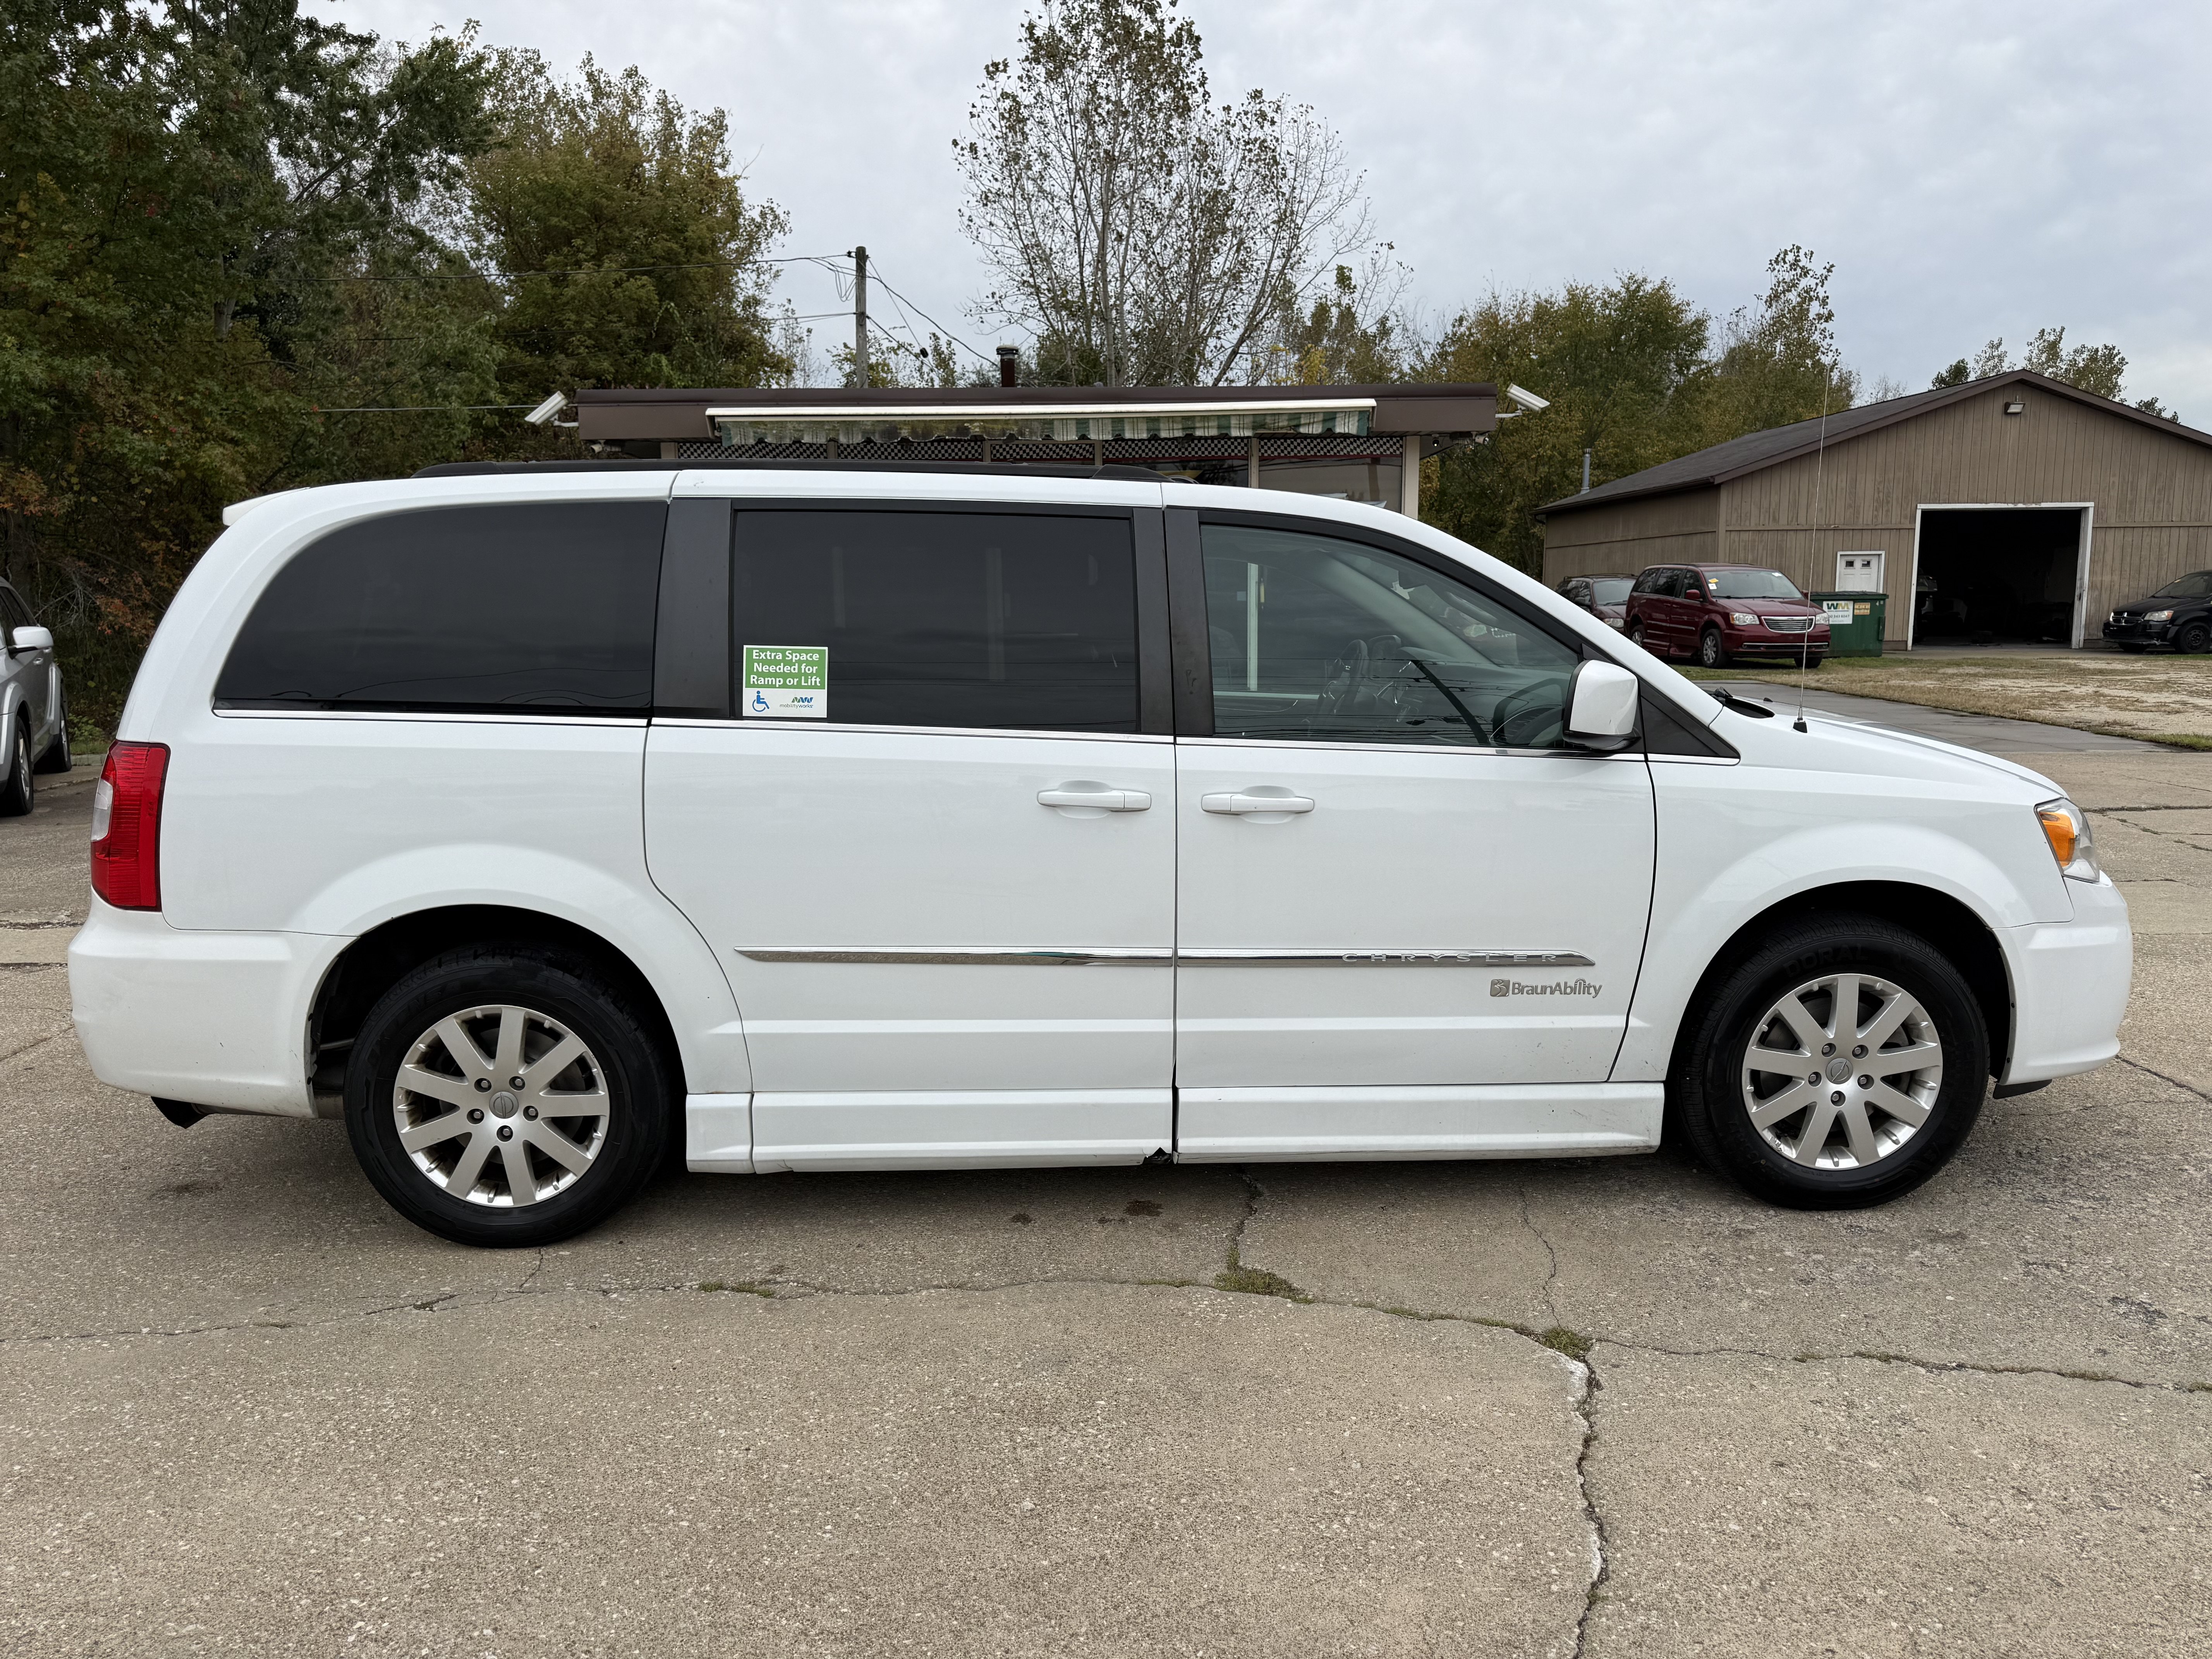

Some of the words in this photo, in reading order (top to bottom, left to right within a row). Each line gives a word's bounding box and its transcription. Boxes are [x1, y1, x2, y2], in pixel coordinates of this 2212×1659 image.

[752, 649, 782, 660] Extra
[785, 650, 819, 662] Space
[754, 663, 798, 673] Needed
[801, 663, 818, 673] for
[750, 675, 783, 687] Ramp
[801, 676, 821, 686] Lift
[1342, 953, 1556, 962] CHRYSLER
[1511, 978, 1602, 998] BraunAbility
